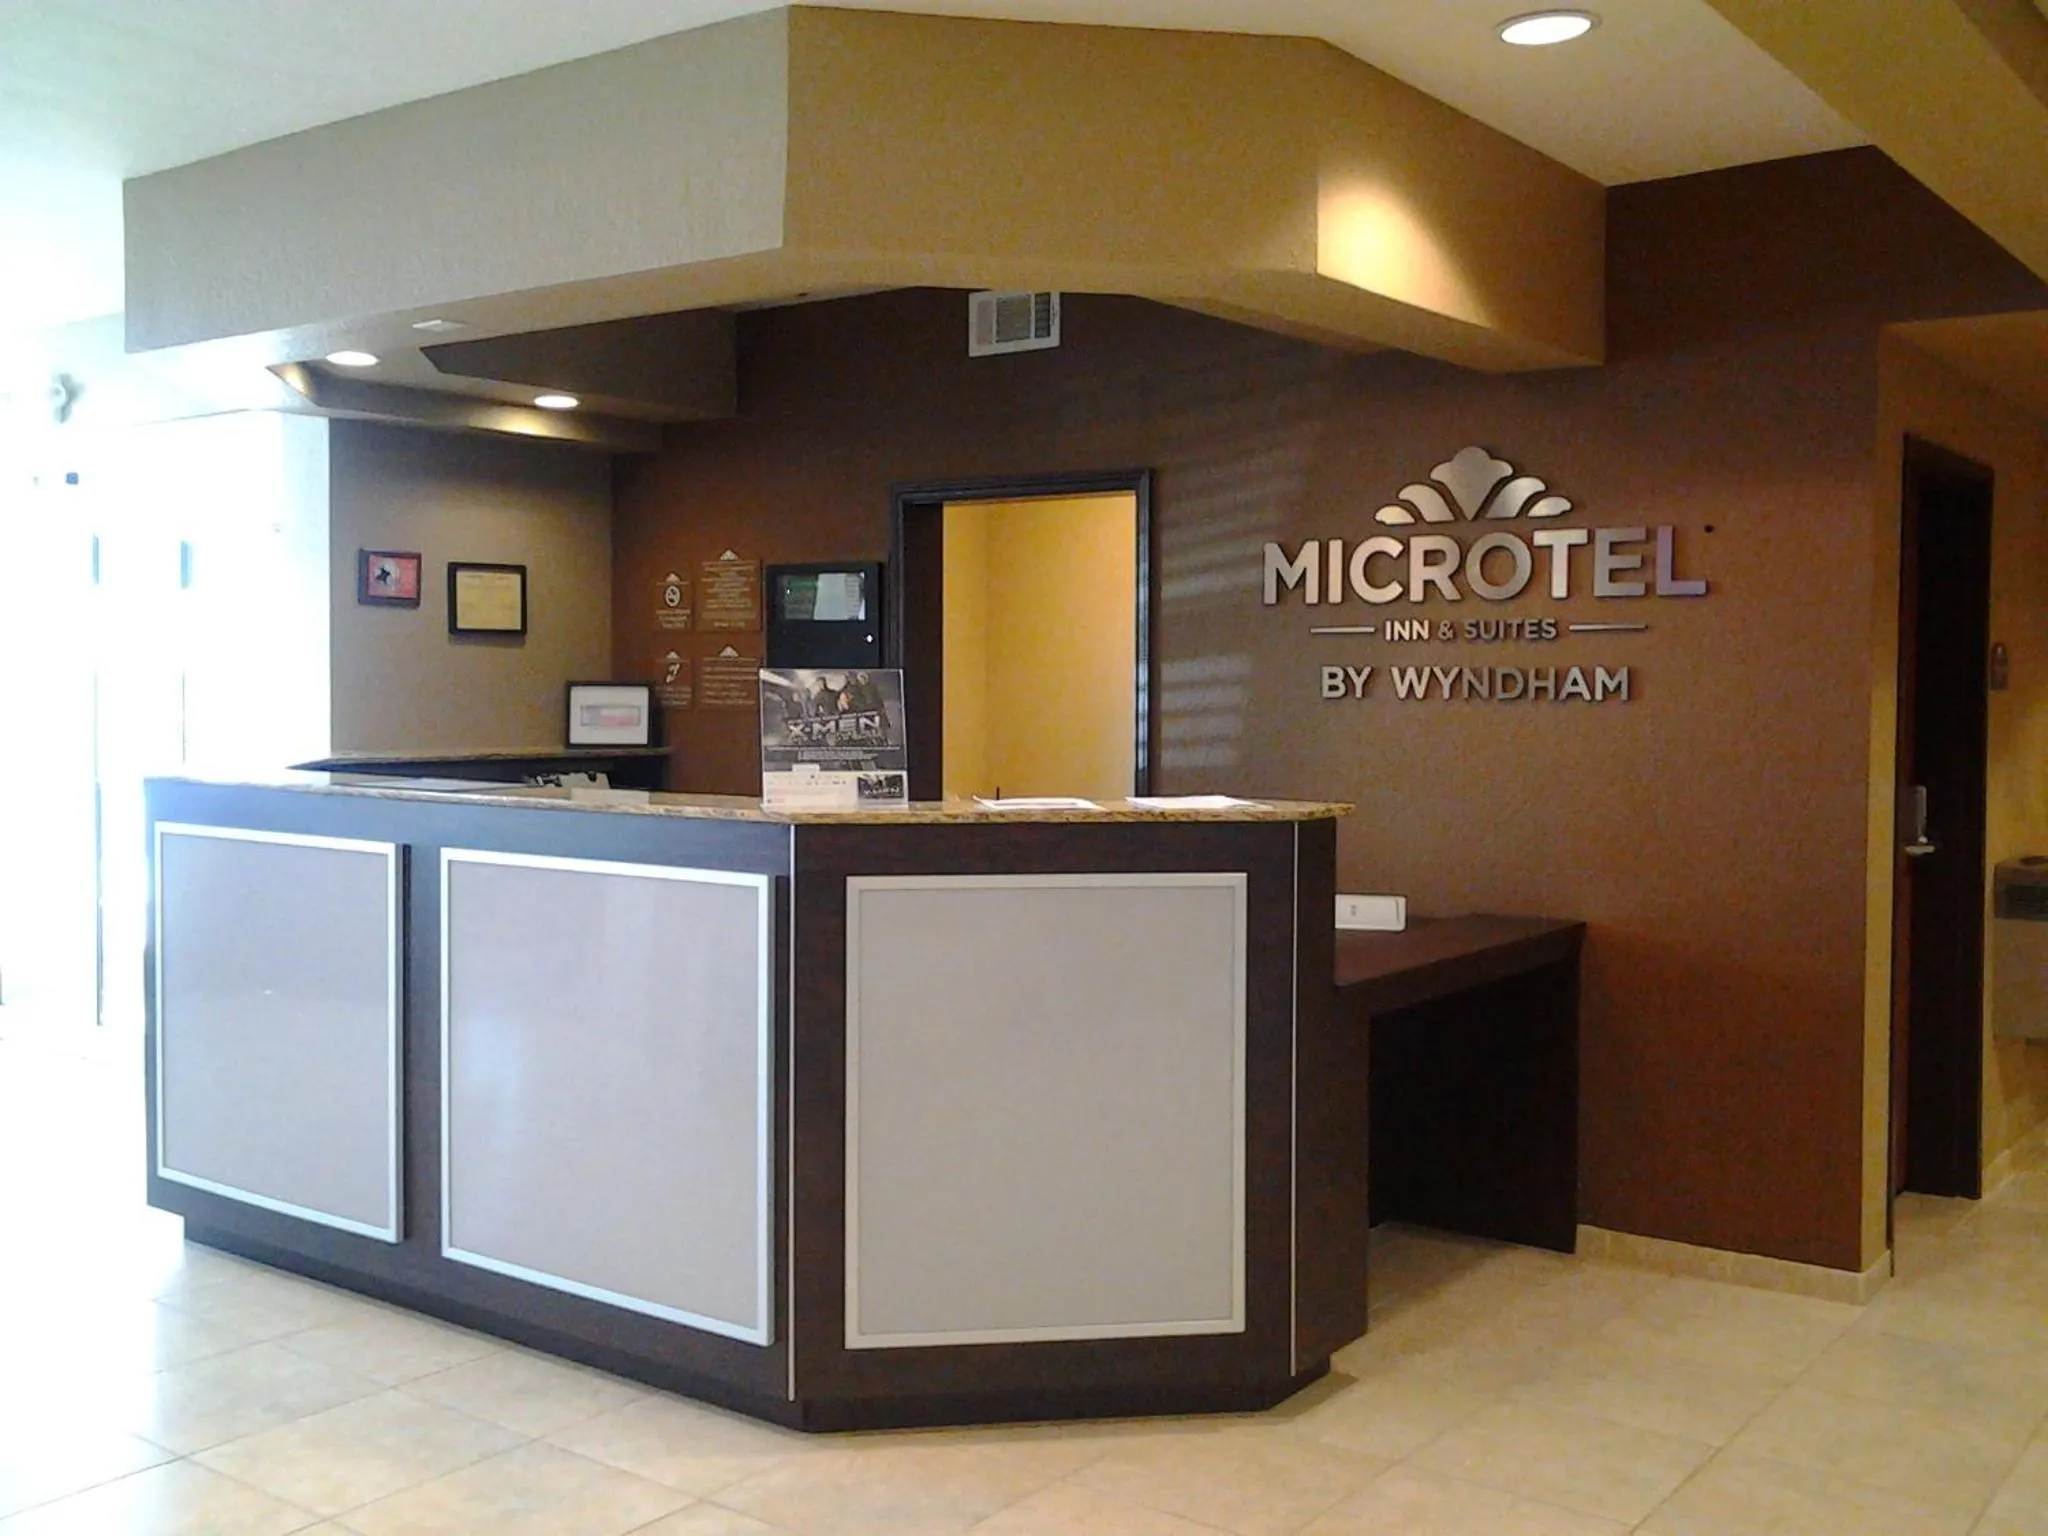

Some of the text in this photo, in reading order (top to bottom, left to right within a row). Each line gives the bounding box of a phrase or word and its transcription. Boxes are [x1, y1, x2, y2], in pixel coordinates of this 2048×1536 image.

[1263, 525, 1707, 605] MICROTEL
[1385, 618, 1558, 641] INN & SUITES
[1321, 665, 1631, 701] BY WYNDHAM
